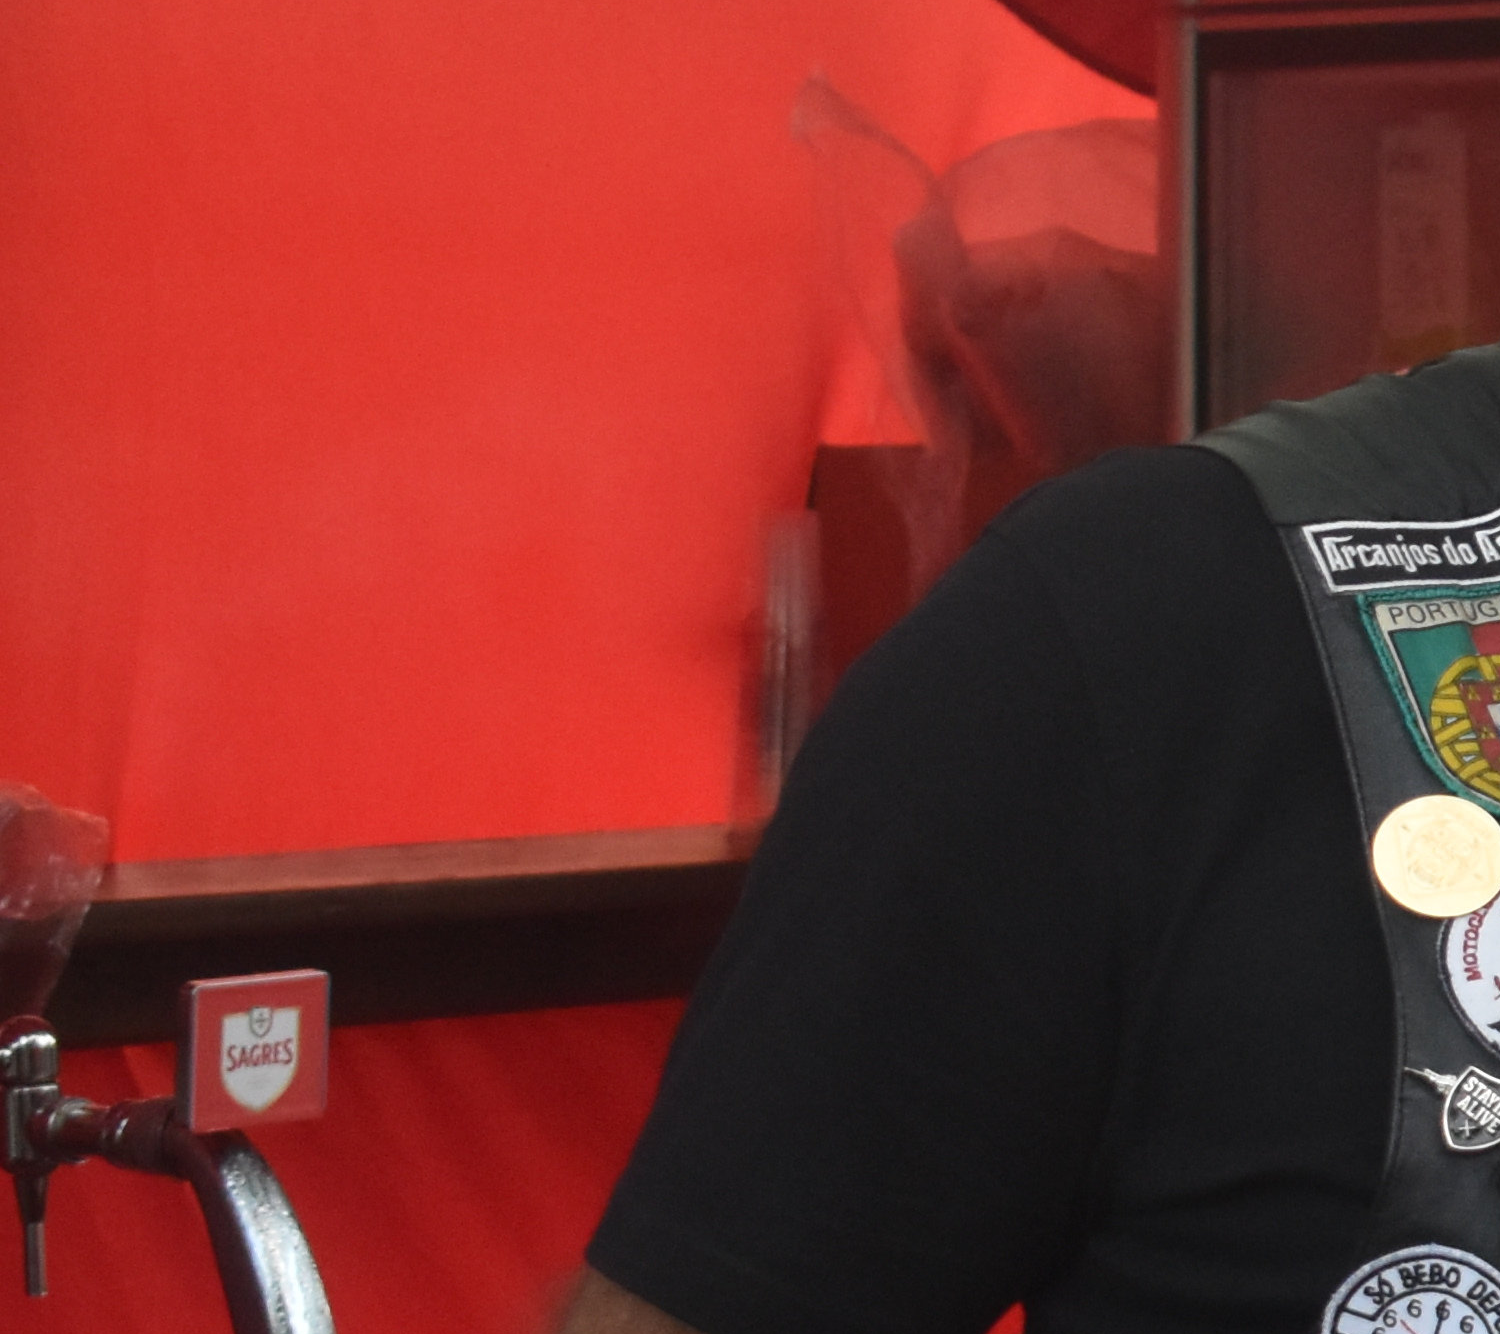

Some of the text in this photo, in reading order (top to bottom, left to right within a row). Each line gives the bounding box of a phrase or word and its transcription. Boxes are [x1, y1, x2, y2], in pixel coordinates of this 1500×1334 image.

[1322, 534, 1442, 573] Arcanjos
[1442, 536, 1478, 566] do
[226, 1038, 294, 1072] SAGRES
[1398, 1263, 1461, 1290] BEBO
[1383, 1309, 1397, 1327] 6
[1407, 1299, 1422, 1318] 6
[1436, 1299, 1450, 1320] 6
[1460, 1315, 1474, 1334] 6
